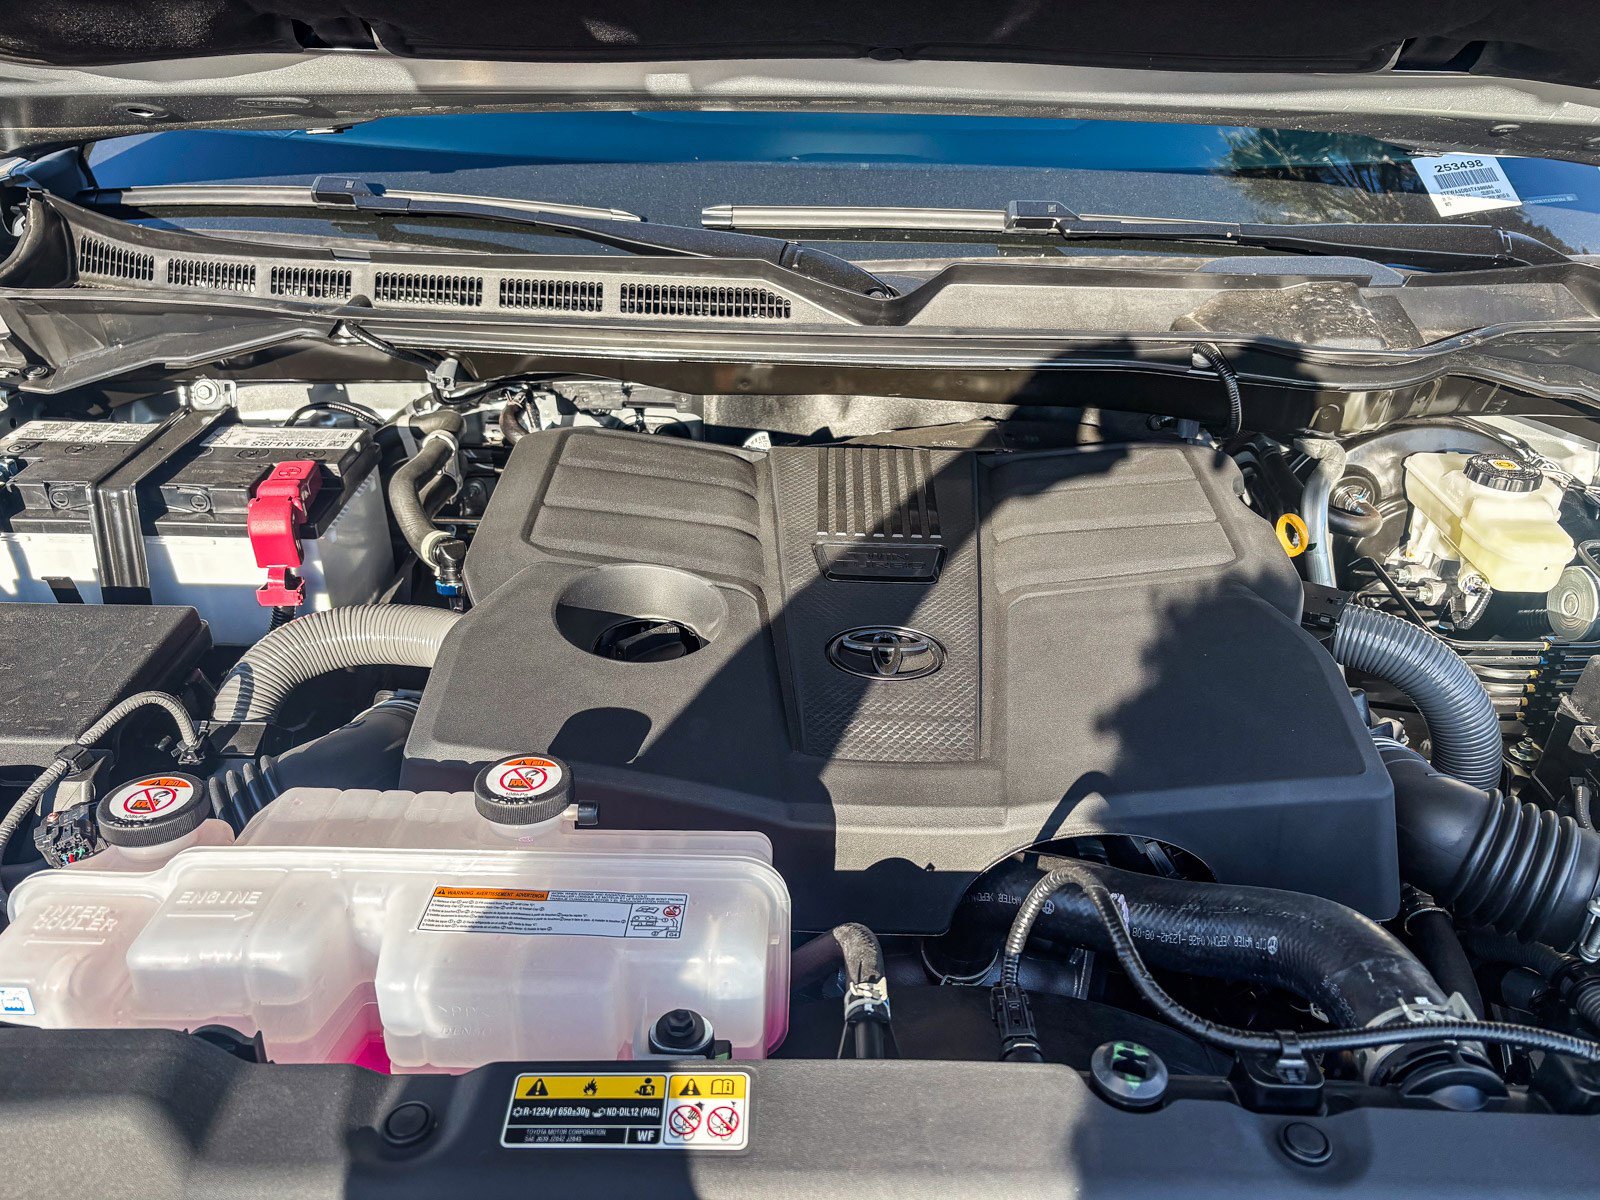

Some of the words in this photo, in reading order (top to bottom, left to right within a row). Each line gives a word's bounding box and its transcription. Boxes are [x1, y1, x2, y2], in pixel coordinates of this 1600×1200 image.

[1434, 159, 1484, 173] 253498
[176, 890, 263, 904] ENGINE
[39, 904, 110, 918] INTER
[33, 916, 118, 932] COOLER
[523, 1106, 558, 1119] R-1234yf
[640, 1107, 660, 1118] (PAG)
[637, 1130, 656, 1141] WF
